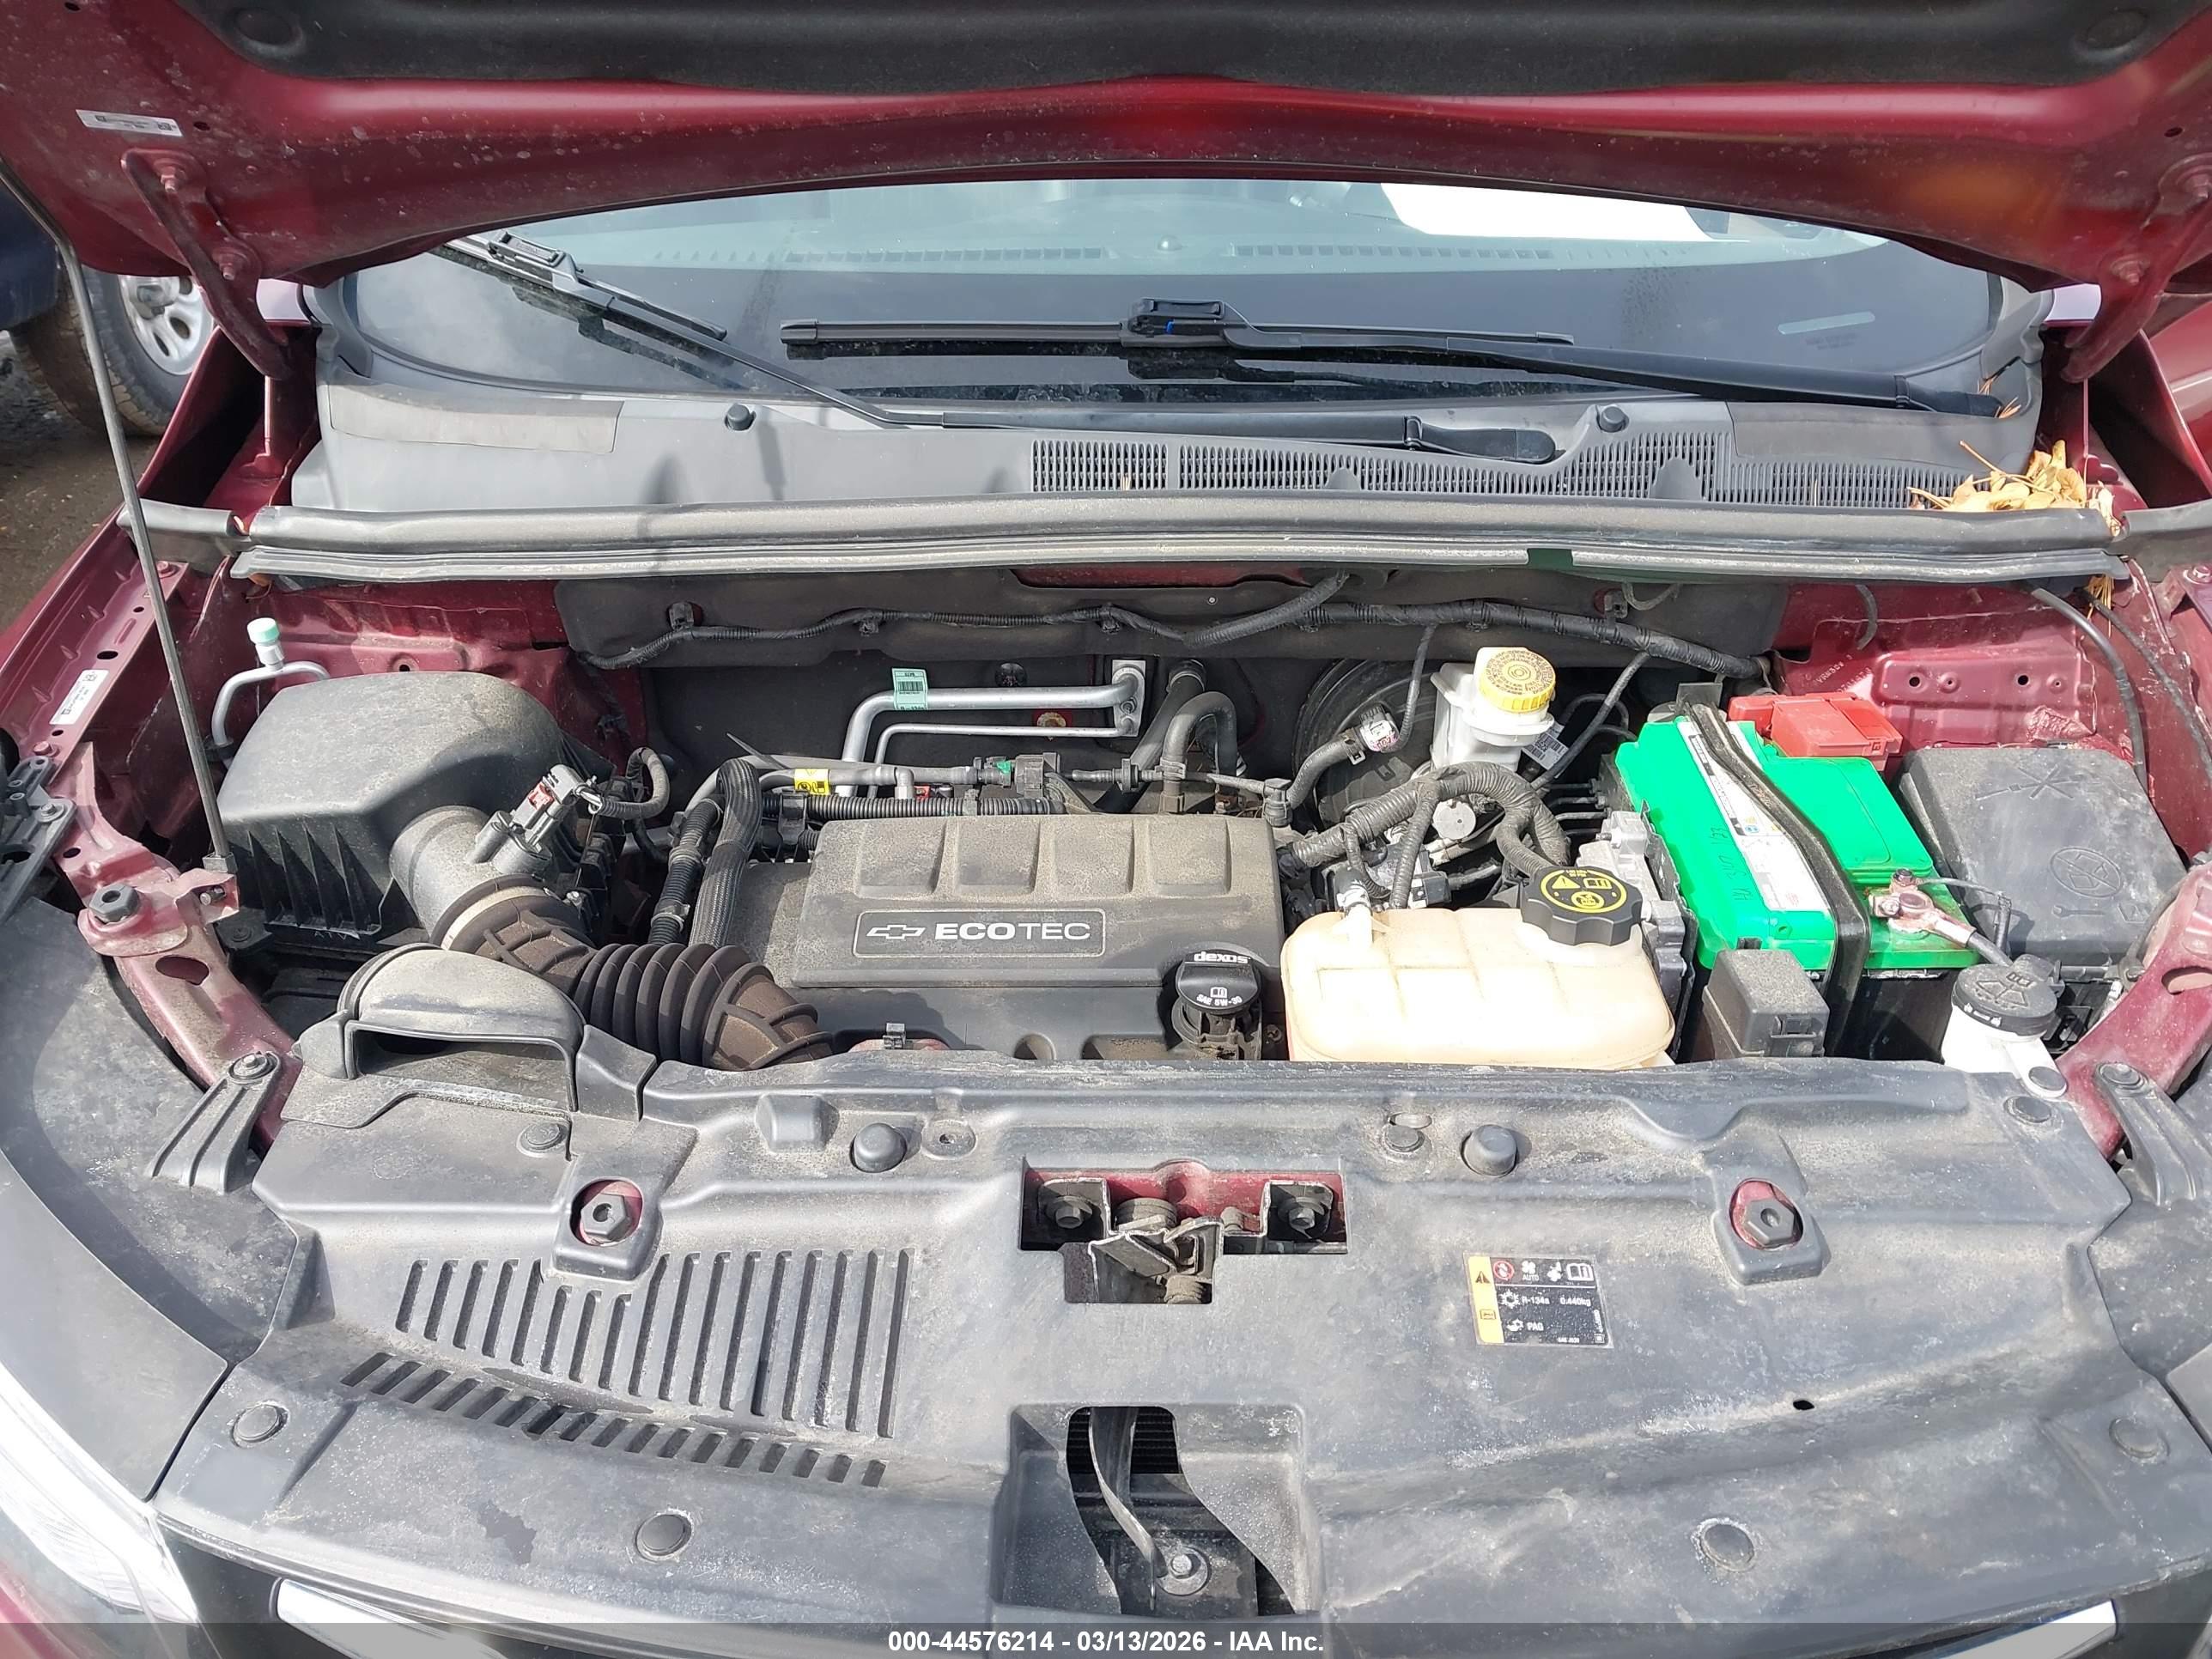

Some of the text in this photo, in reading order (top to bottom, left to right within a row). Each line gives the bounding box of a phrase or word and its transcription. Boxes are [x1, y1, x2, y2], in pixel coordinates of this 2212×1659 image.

[934, 922, 1091, 940] ECOTEC
[1194, 951, 1249, 963] dexos
[1196, 994, 1243, 1006] SAE 5W-30
[1522, 1297, 1550, 1305] R-134a
[1527, 1322, 1544, 1331] PAG
